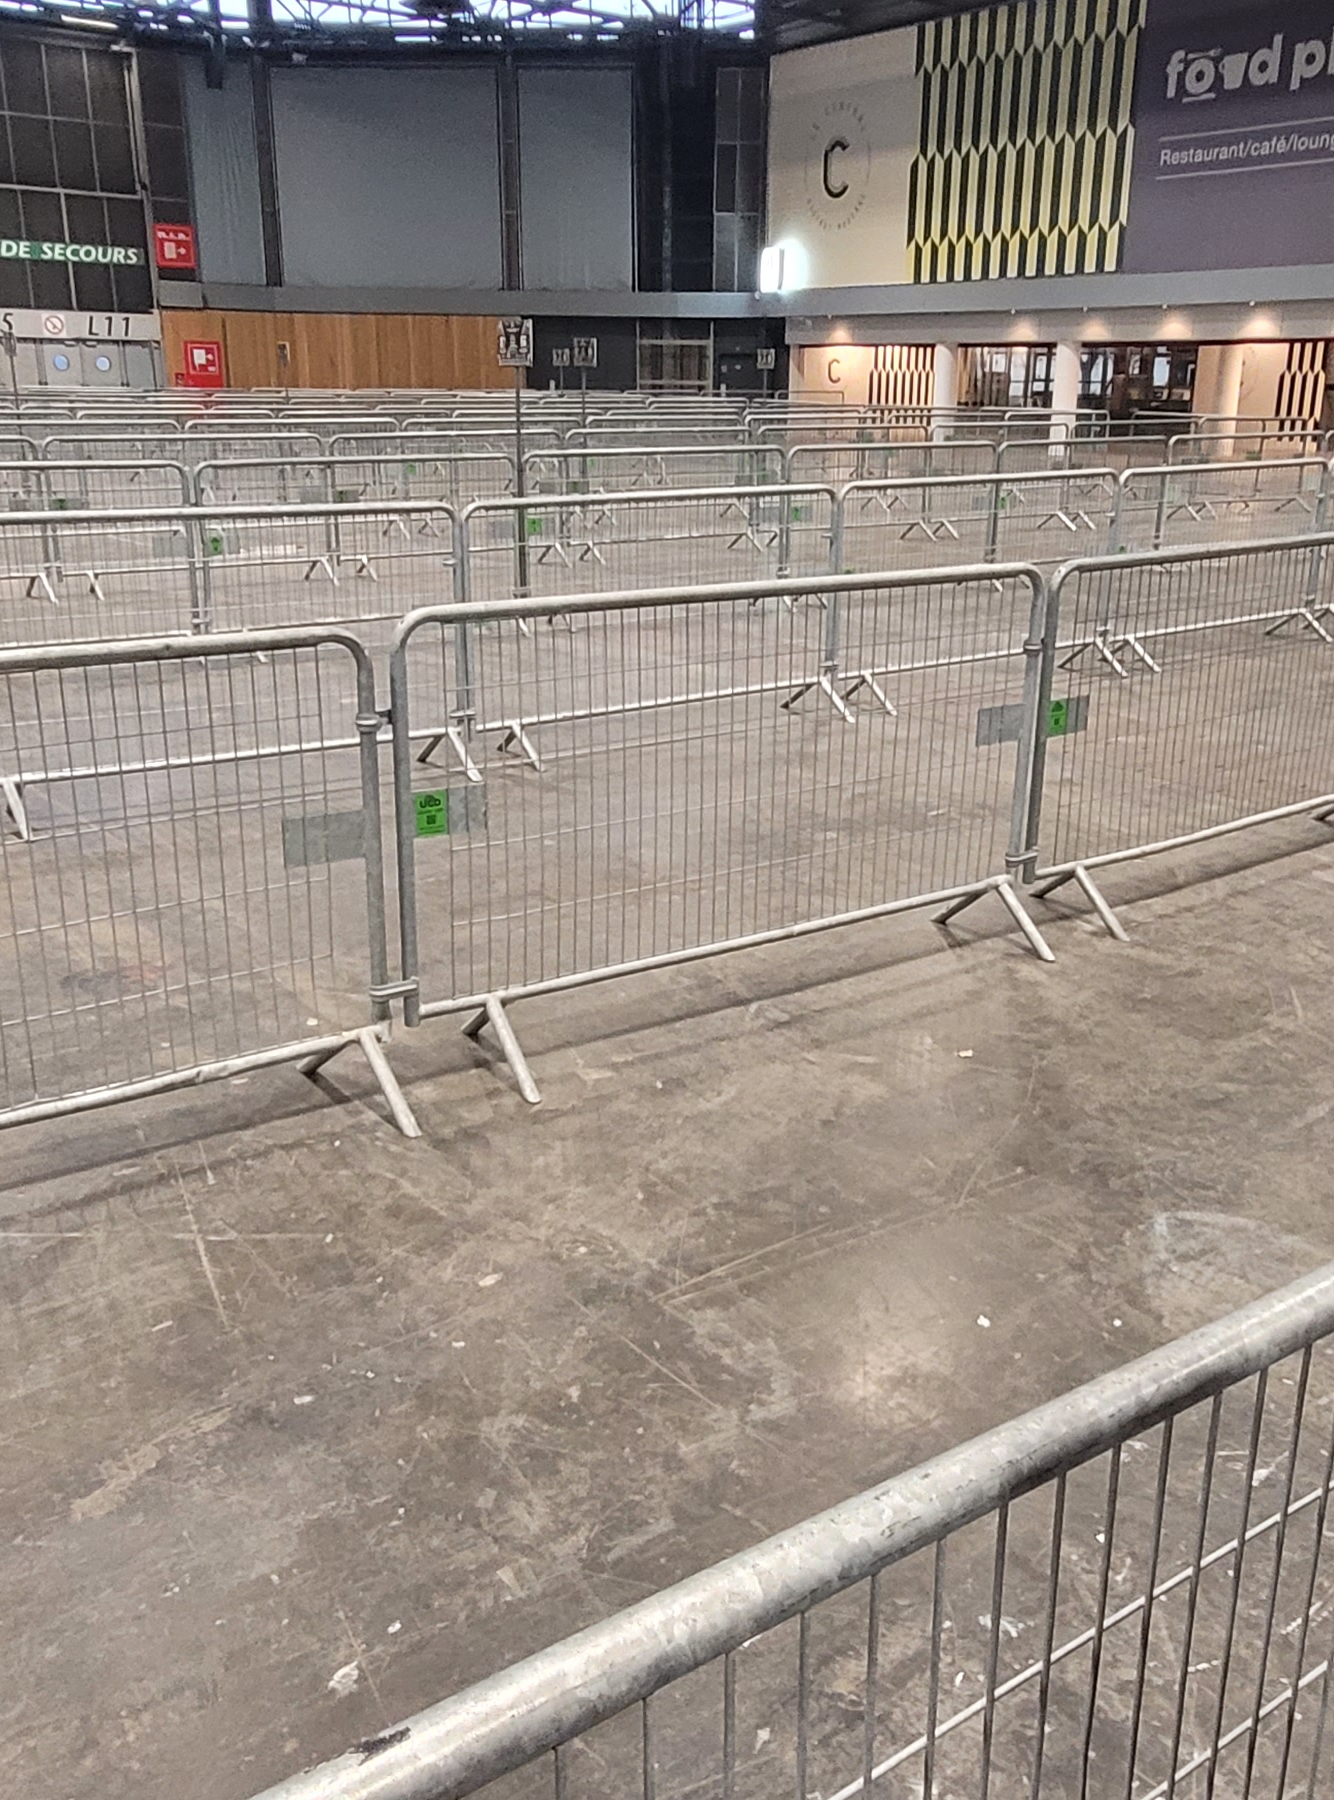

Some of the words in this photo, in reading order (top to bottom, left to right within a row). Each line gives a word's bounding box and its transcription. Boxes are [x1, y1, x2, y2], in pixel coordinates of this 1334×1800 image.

[0, 240, 31, 258] DE
[40, 243, 139, 264] SECOURS
[2, 312, 14, 332] 5
[87, 314, 132, 338] L11
